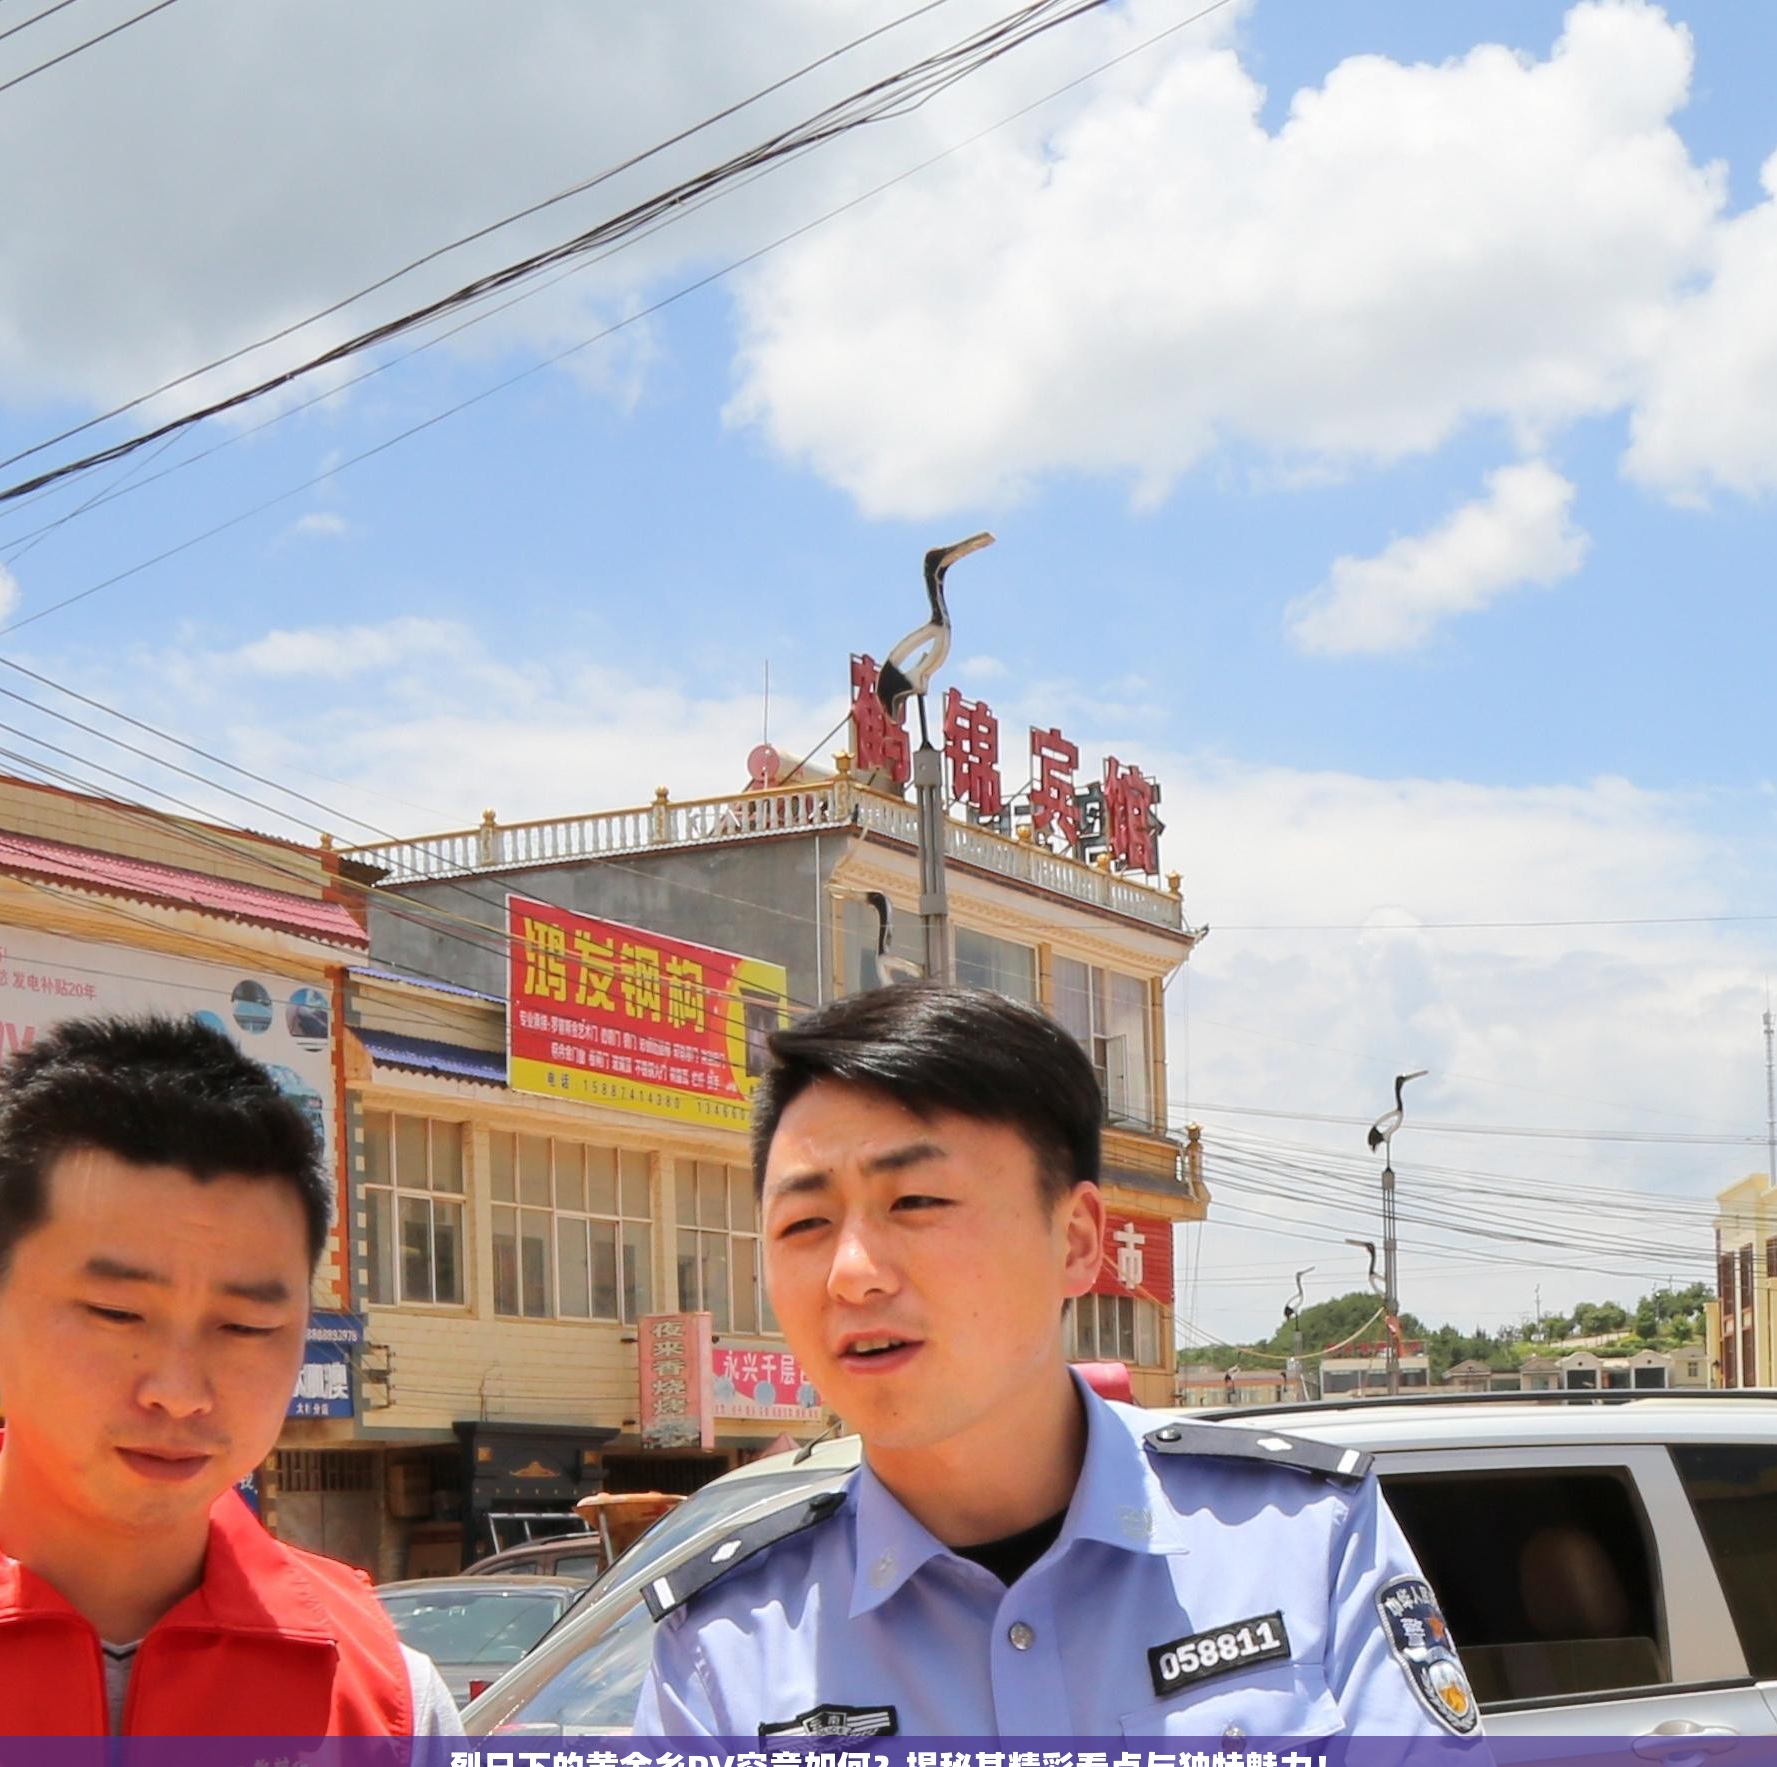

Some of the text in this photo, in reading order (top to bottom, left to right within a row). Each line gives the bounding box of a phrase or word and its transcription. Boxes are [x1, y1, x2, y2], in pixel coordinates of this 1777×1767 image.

[523, 916, 705, 1034] 鸿发钢构
[1113, 1222, 1145, 1290] 市
[1159, 1621, 1281, 1682] 058811
